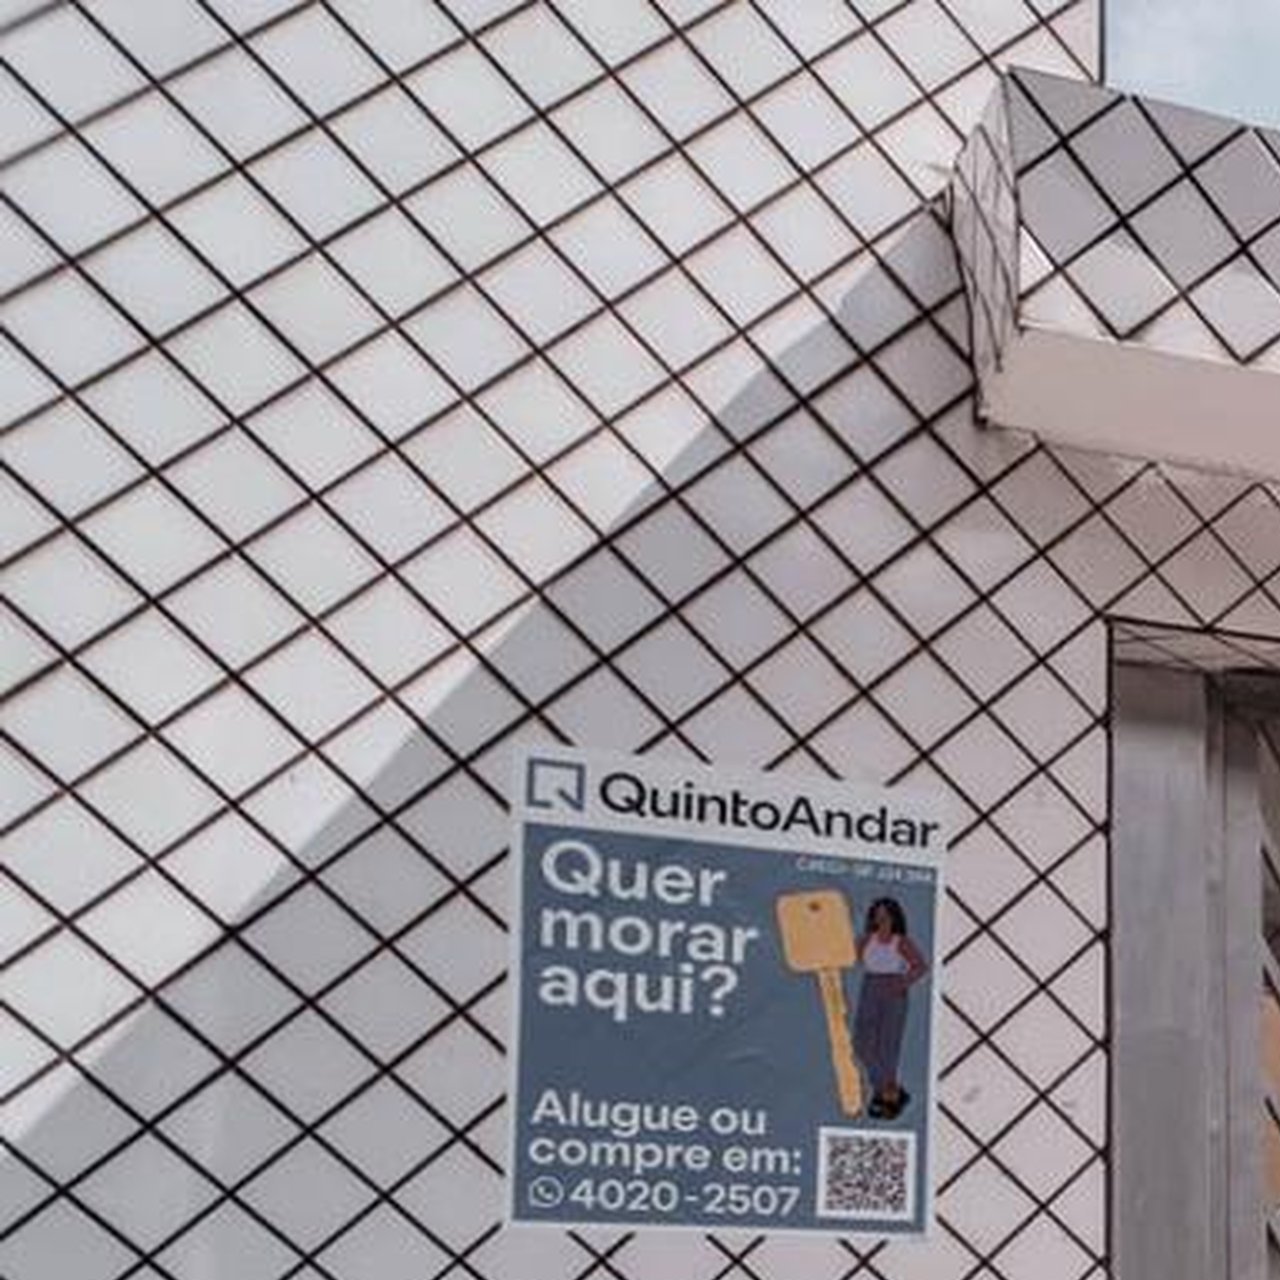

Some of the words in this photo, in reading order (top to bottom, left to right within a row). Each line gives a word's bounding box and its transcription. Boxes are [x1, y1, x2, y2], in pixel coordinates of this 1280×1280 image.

[599, 772, 939, 849] QuintoAndar
[540, 840, 727, 907] Quer
[540, 907, 759, 964] morar
[538, 962, 738, 1022] aqui?
[530, 1089, 700, 1138] Alugue
[710, 1107, 767, 1135] ou
[528, 1137, 712, 1175] compre
[722, 1145, 801, 1176] em:
[569, 1179, 801, 1216] 4020-2507
